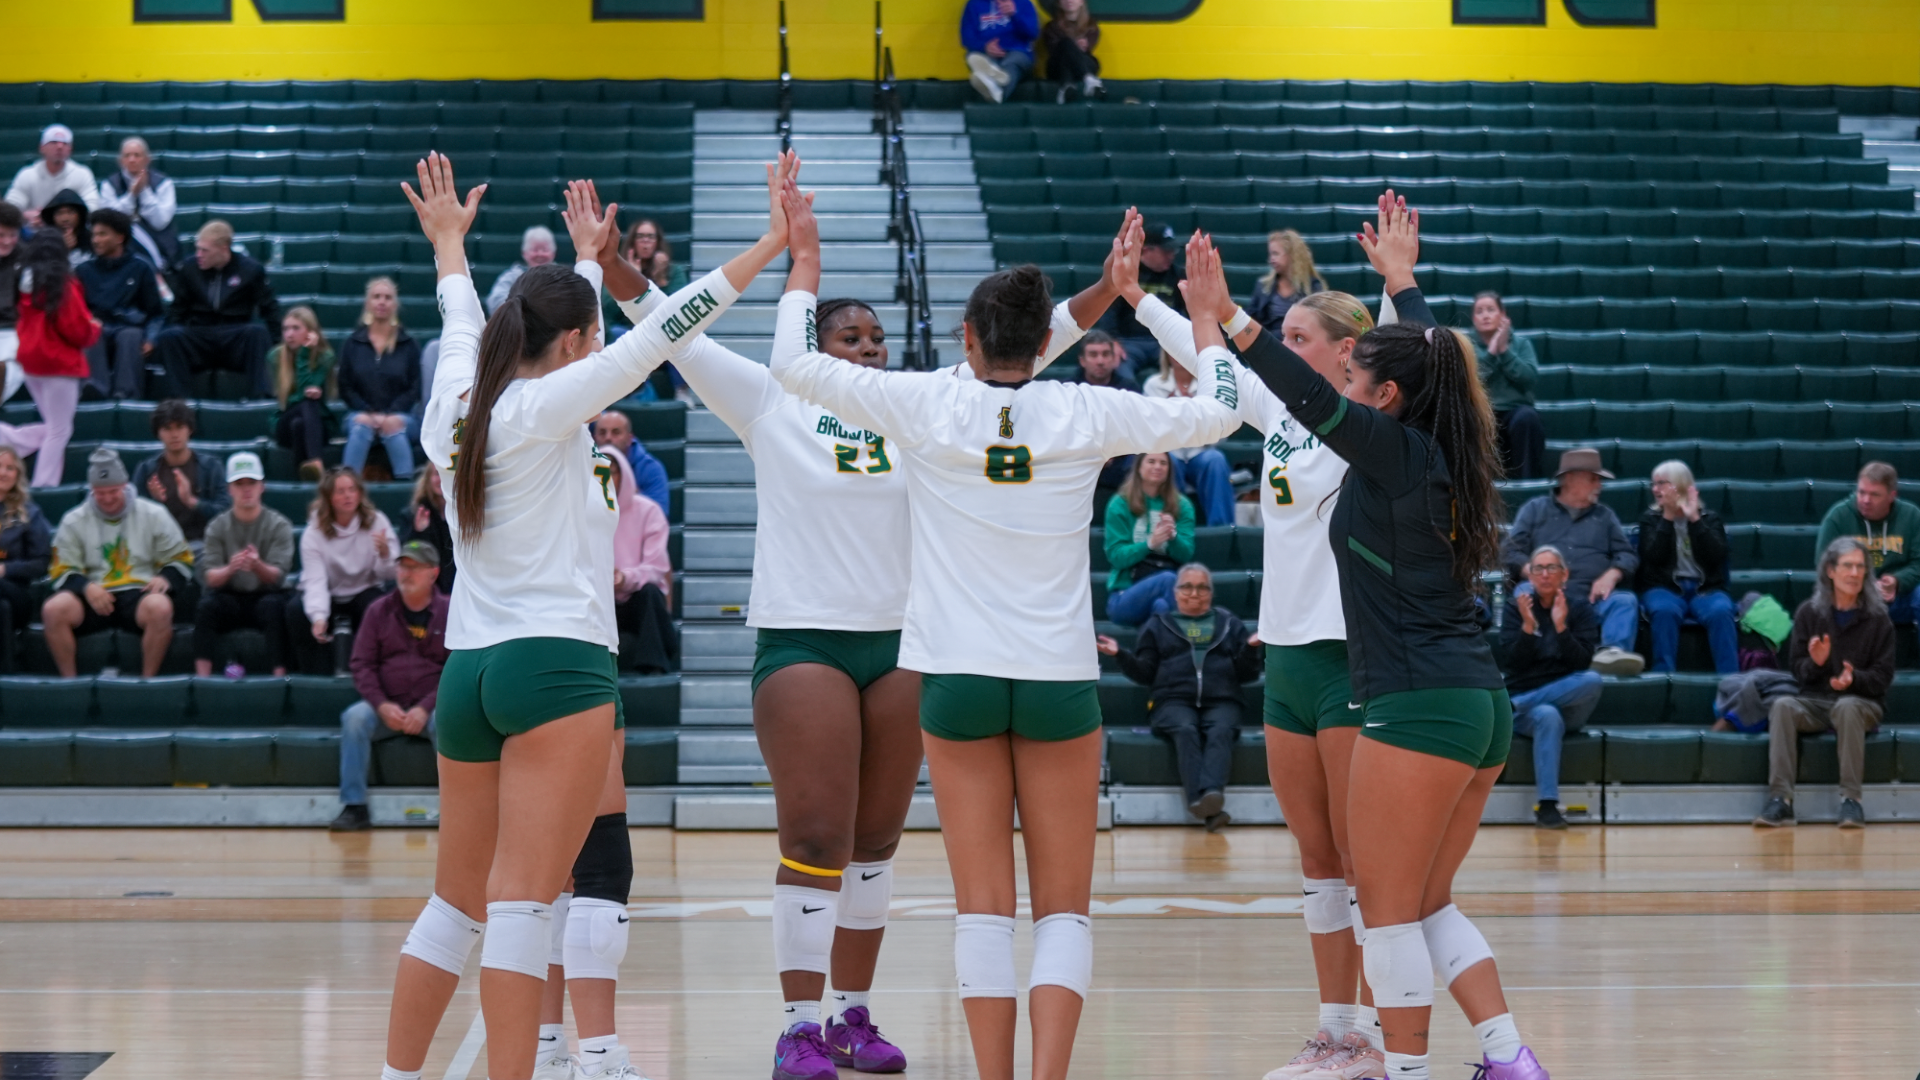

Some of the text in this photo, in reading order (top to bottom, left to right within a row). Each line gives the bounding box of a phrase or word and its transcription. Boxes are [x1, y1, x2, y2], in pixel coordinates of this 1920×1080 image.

[661, 288, 719, 343] GOLDEN
[1214, 359, 1238, 410] GOLDEN
[833, 434, 893, 474] 23
[984, 444, 1033, 485] 8
[1268, 462, 1294, 506] 5
